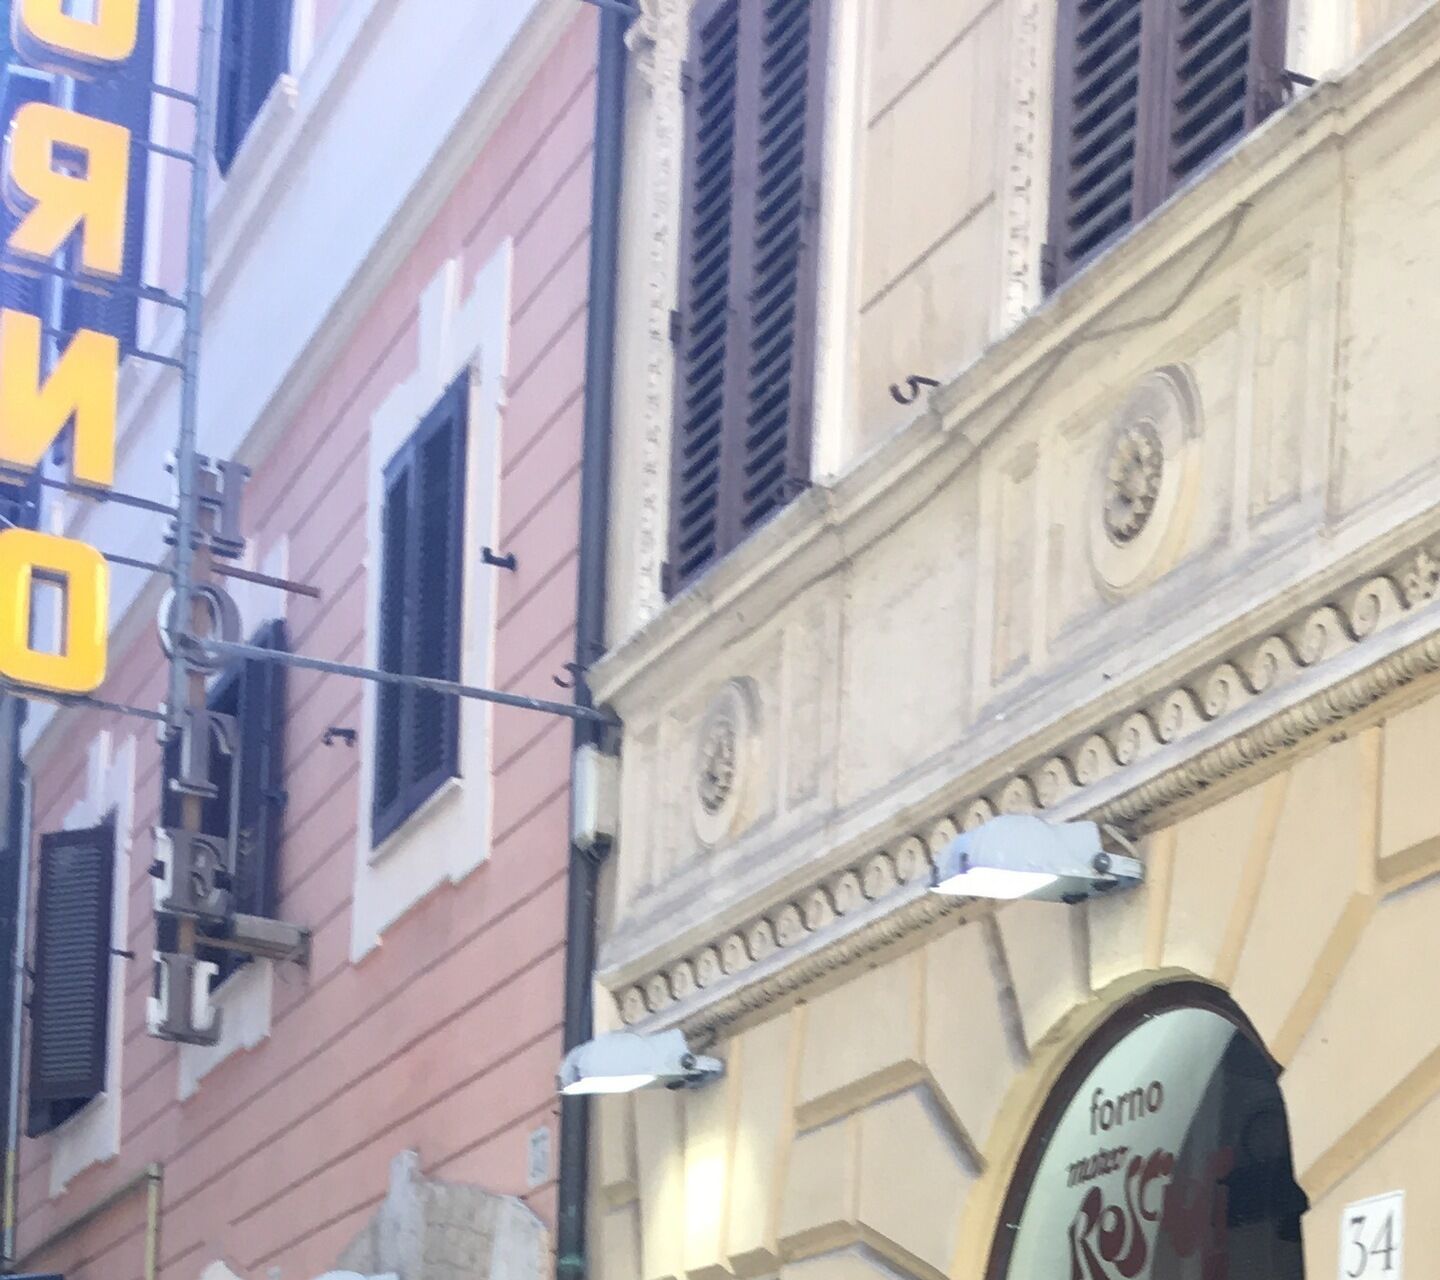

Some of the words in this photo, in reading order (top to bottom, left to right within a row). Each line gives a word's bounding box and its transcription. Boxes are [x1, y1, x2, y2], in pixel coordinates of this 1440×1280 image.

[147, 450, 251, 1046] HOTEL
[1090, 1079, 1164, 1136] forno
[1346, 1207, 1398, 1279] 34
